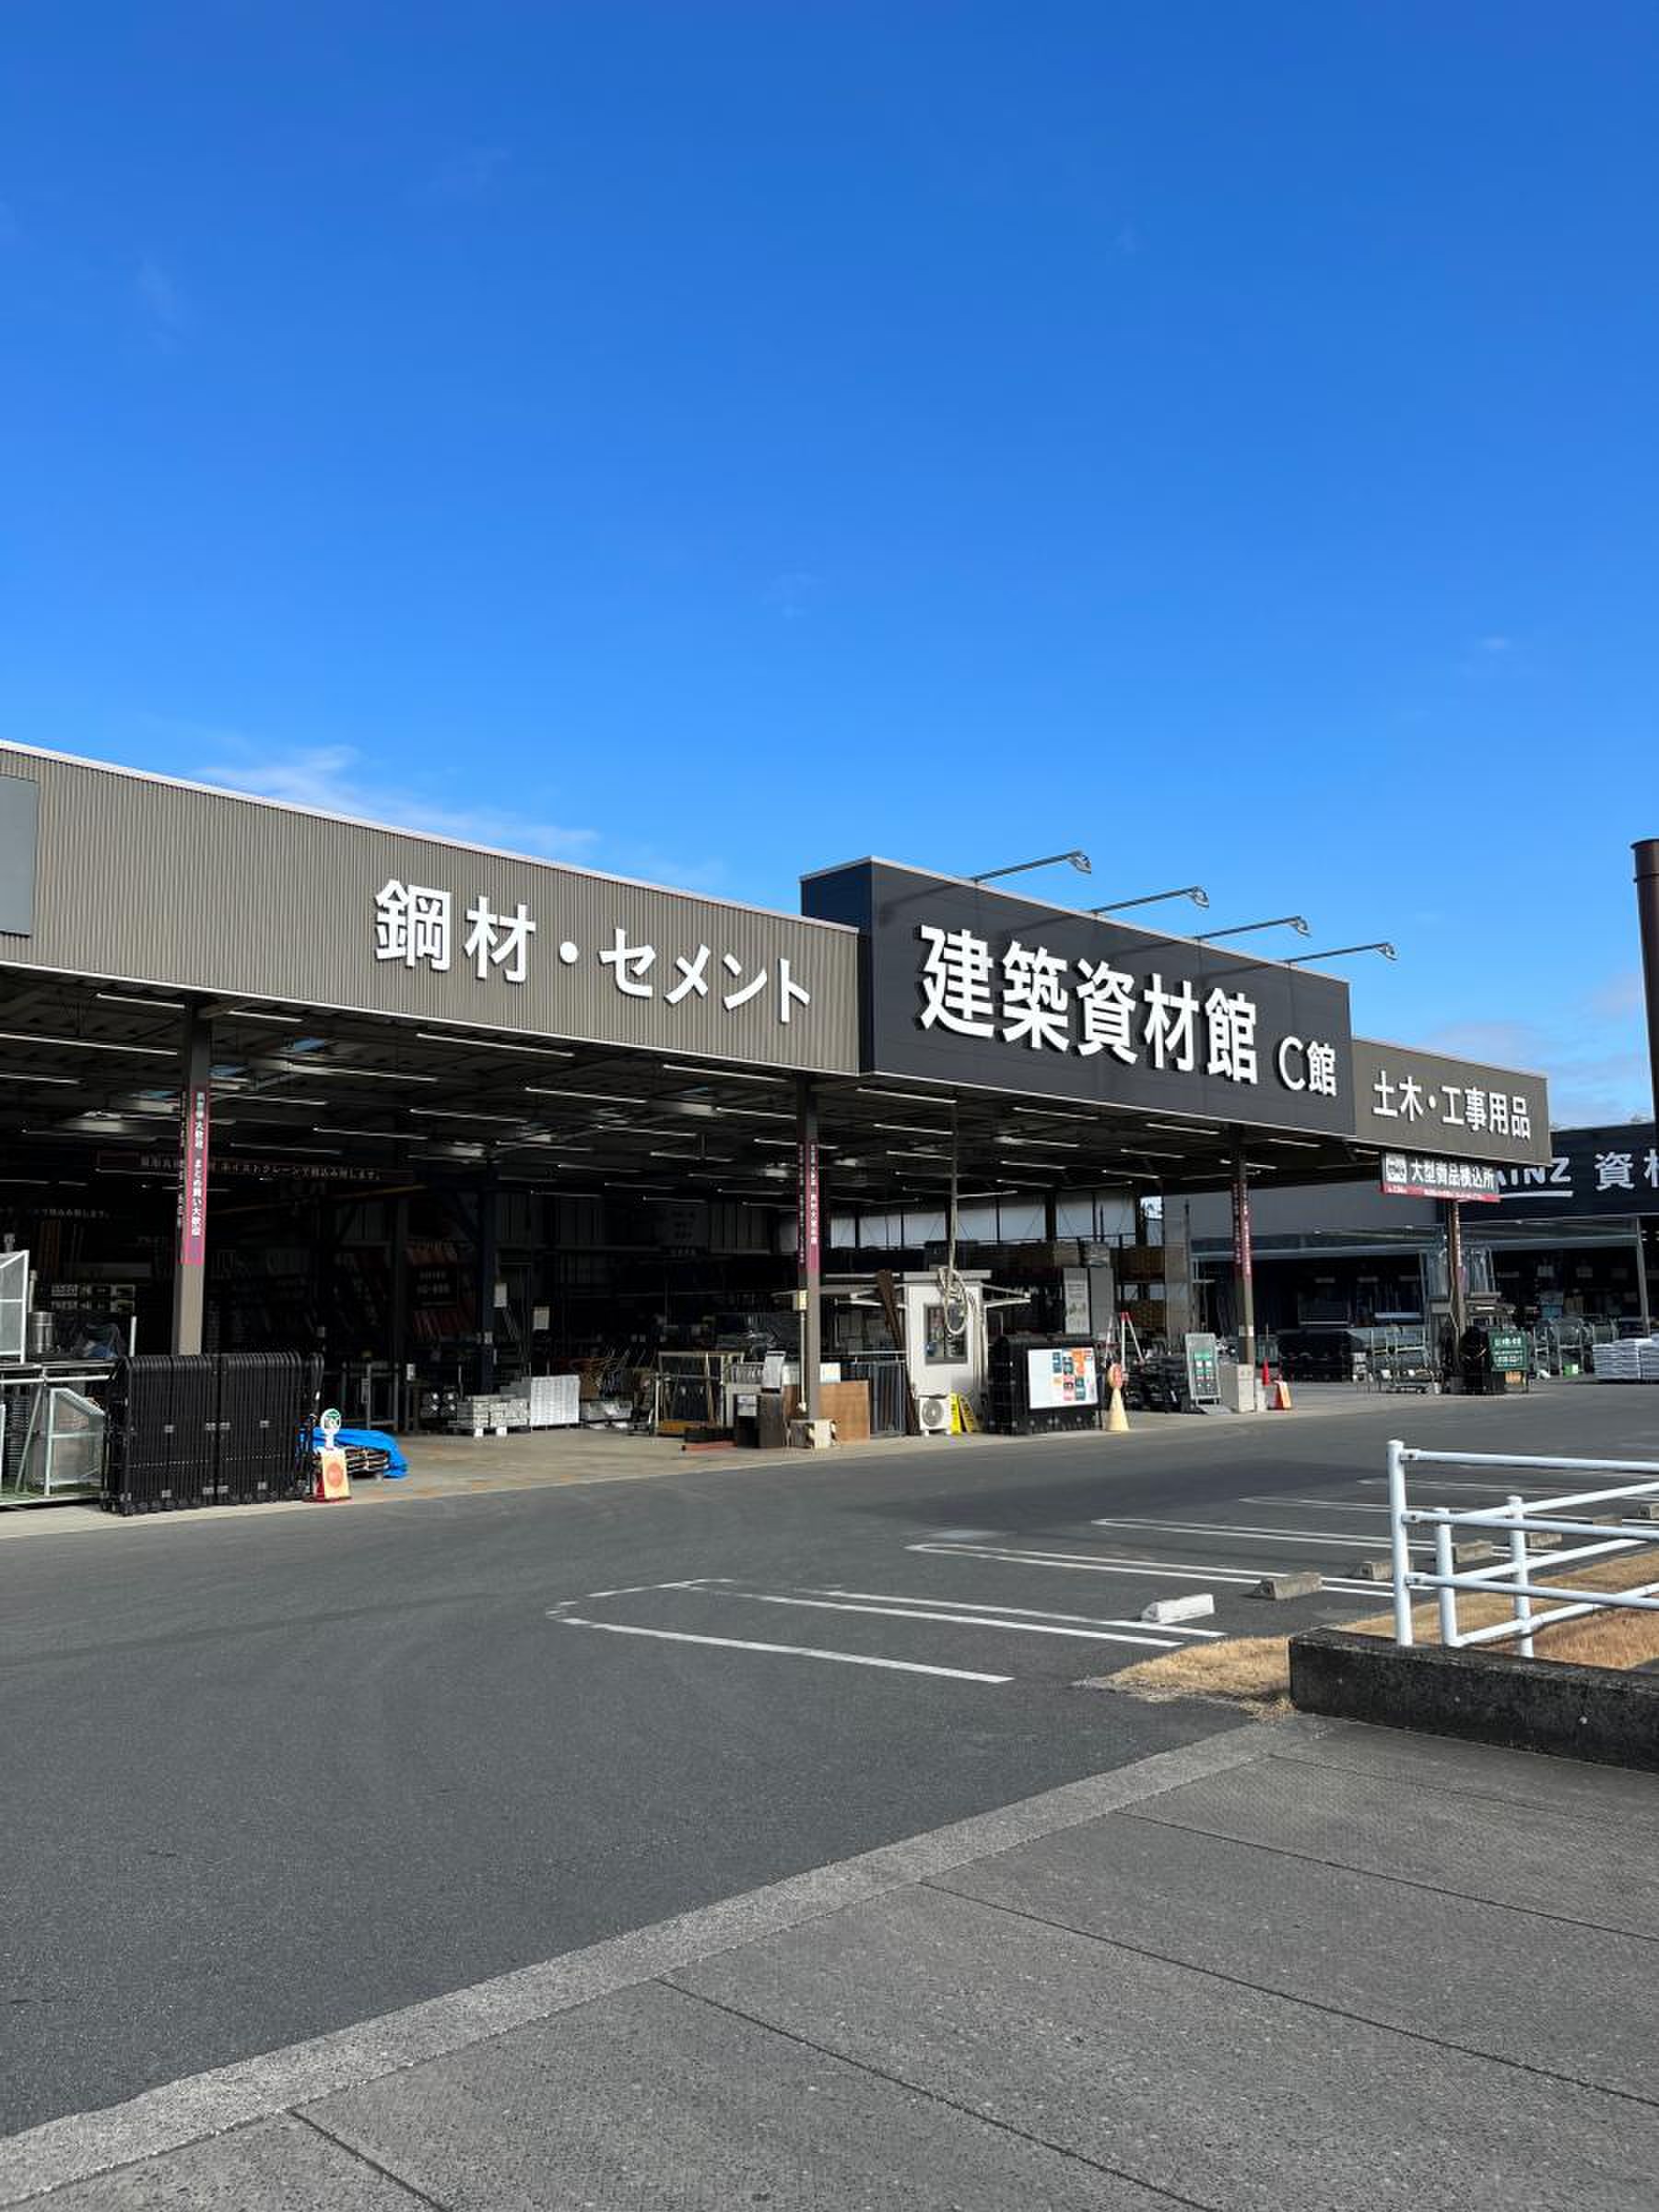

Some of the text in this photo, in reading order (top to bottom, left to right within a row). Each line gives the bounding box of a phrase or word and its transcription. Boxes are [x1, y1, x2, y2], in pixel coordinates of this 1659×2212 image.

[375, 879, 811, 1023] 鋼材・セメント
[920, 924, 1337, 1097] 建築資材館 C館
[1373, 1070, 1532, 1140] 土木・工事用品
